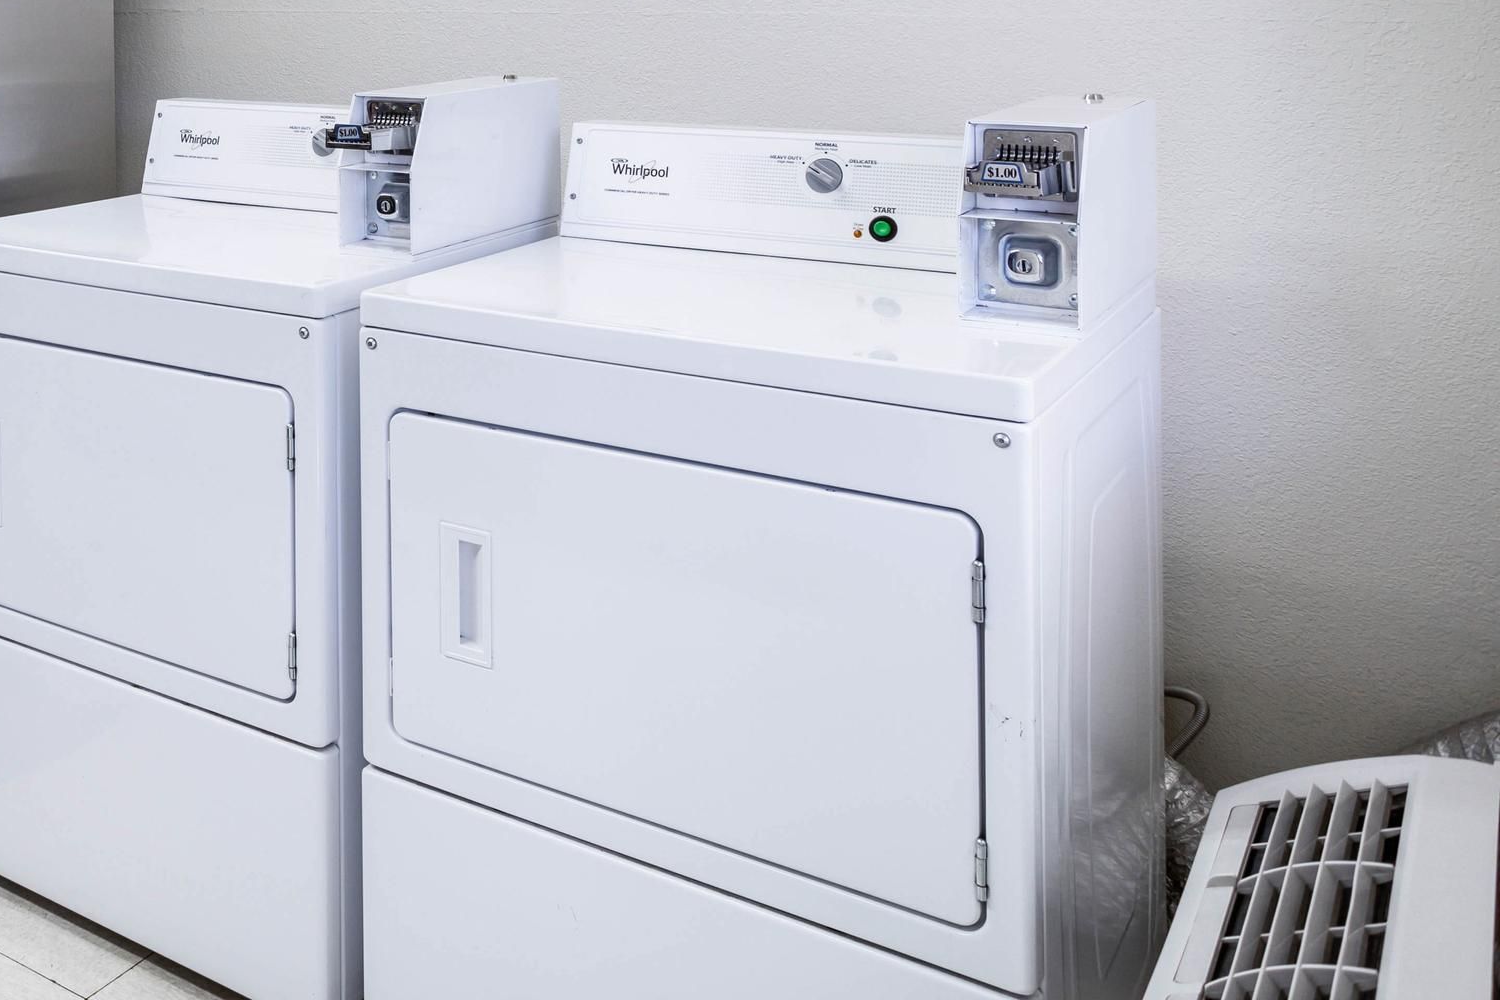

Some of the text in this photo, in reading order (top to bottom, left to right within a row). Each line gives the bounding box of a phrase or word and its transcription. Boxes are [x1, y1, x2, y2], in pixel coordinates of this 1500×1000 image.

[339, 128, 358, 137] $1.00
[180, 133, 220, 147] Whirlpool
[612, 163, 669, 180] Whirlpool
[987, 166, 1017, 179] $1.00
[872, 206, 897, 214] START
